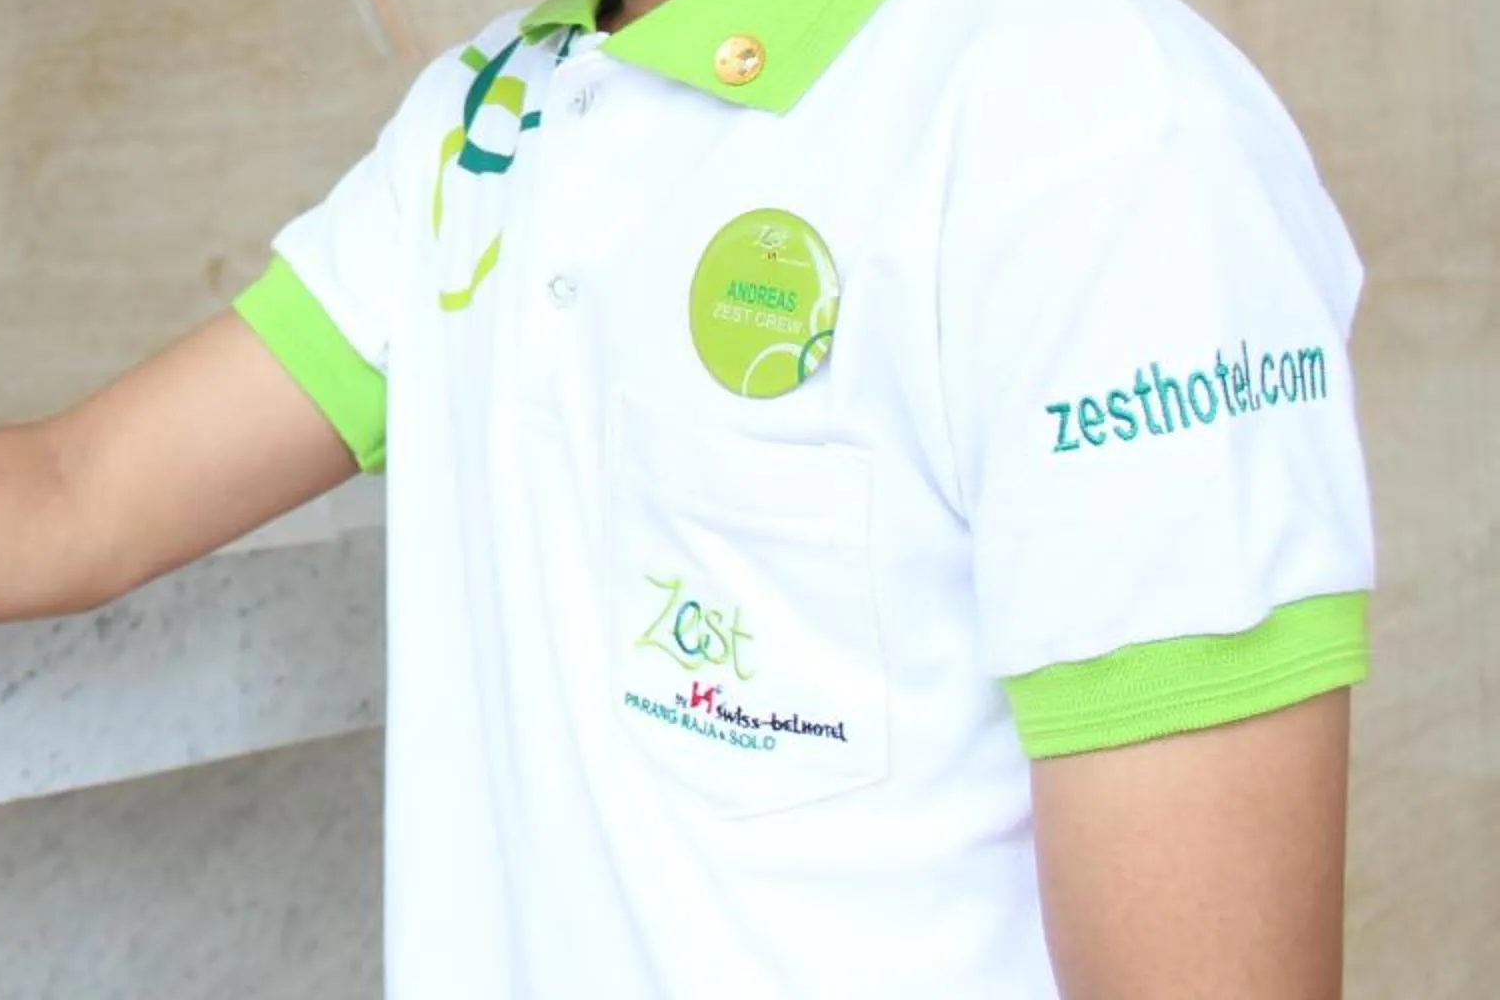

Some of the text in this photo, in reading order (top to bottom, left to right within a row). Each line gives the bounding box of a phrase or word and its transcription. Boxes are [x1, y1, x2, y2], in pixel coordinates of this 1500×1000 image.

[711, 300, 804, 335] ZEST CREW
[727, 280, 797, 313] ANDREAS
[1046, 339, 1327, 453] zesthotel.com
[634, 574, 756, 681] Zest
[625, 691, 777, 751] PARANG RAJA SOLO
